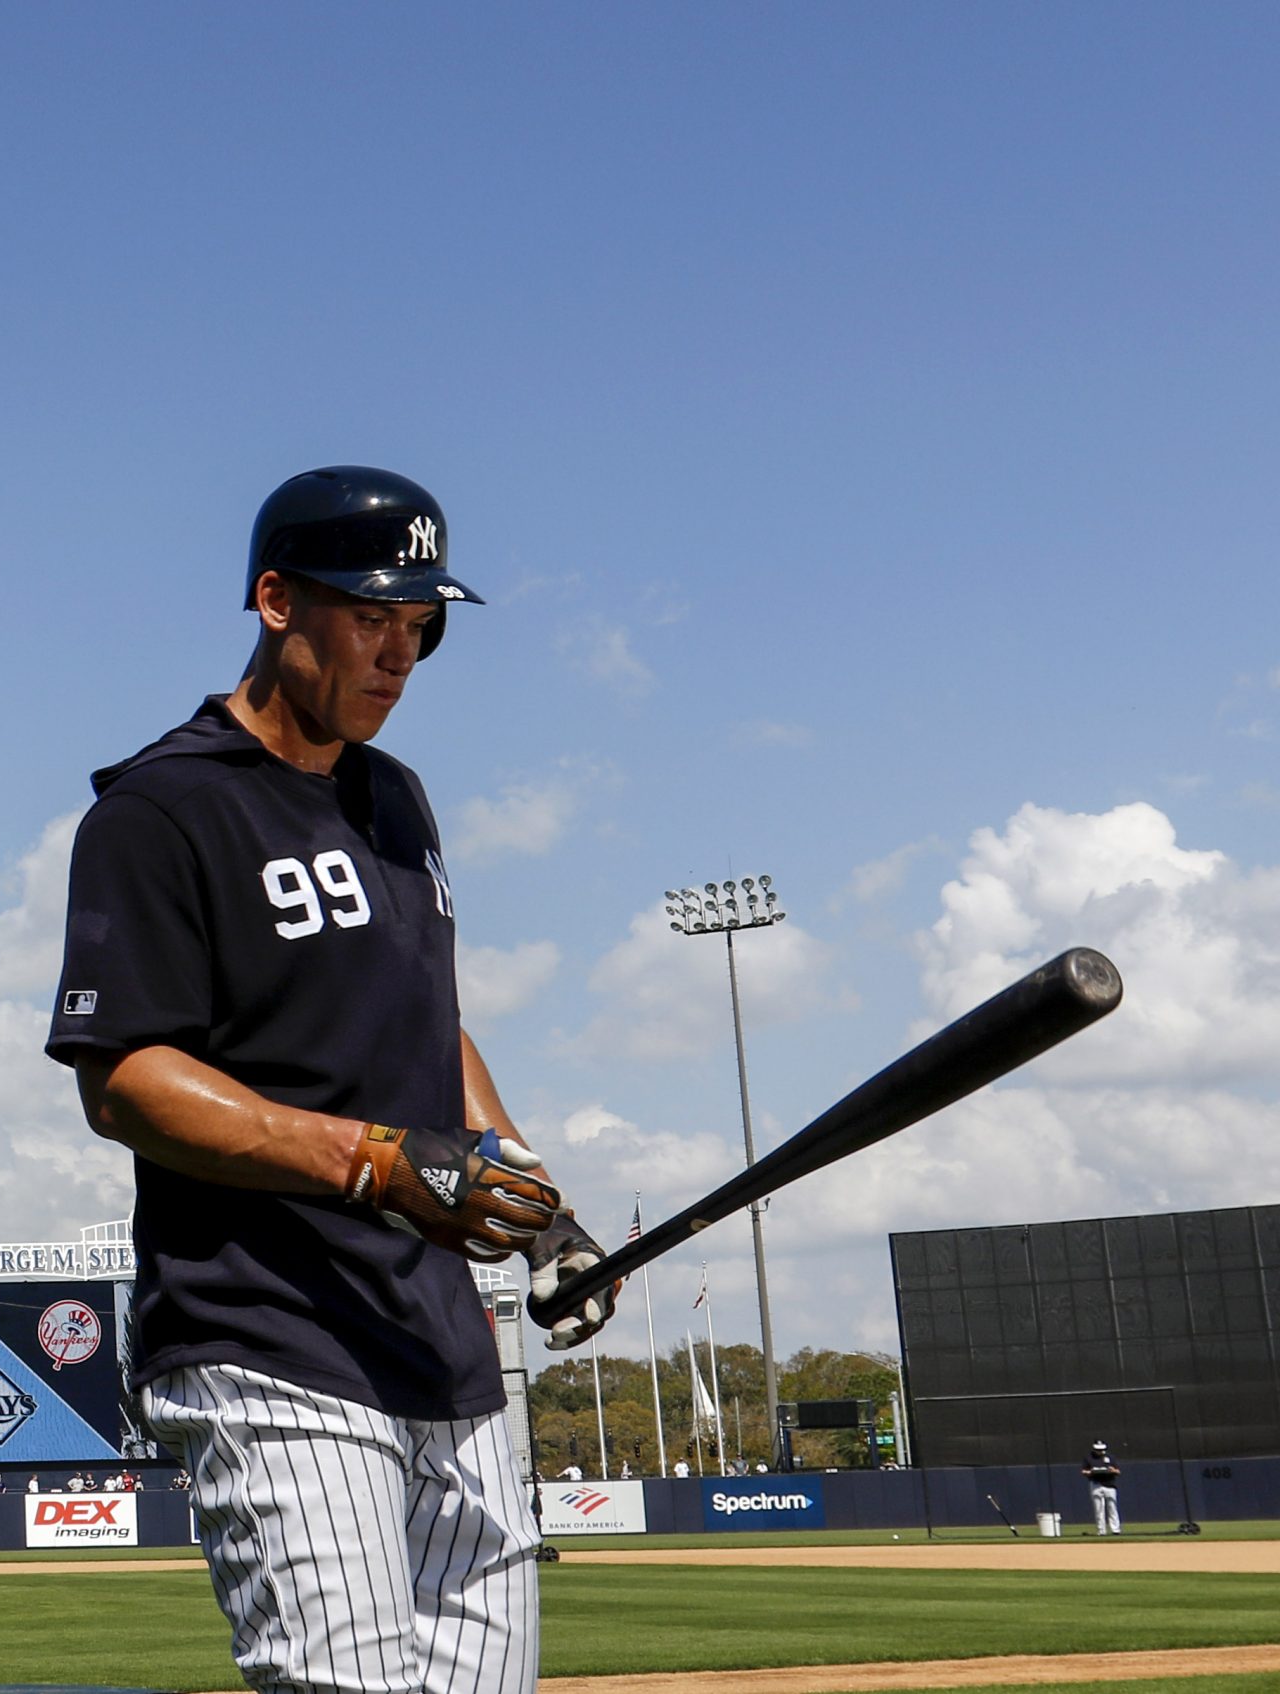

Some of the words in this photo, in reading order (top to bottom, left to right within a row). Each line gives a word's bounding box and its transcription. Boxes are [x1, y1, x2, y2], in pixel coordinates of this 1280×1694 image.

[408, 515, 438, 560] NY
[436, 585, 465, 599] 99
[261, 849, 372, 940] 99
[421, 1167, 456, 1206] adidas
[53, 1248, 81, 1270] M.
[89, 1247, 136, 1271] STE
[41, 1321, 98, 1349] Yankees
[1202, 1466, 1232, 1479] 408
[34, 1500, 121, 1525] DEX
[712, 1492, 807, 1515] Spectrum
[55, 1526, 130, 1538] imaging
